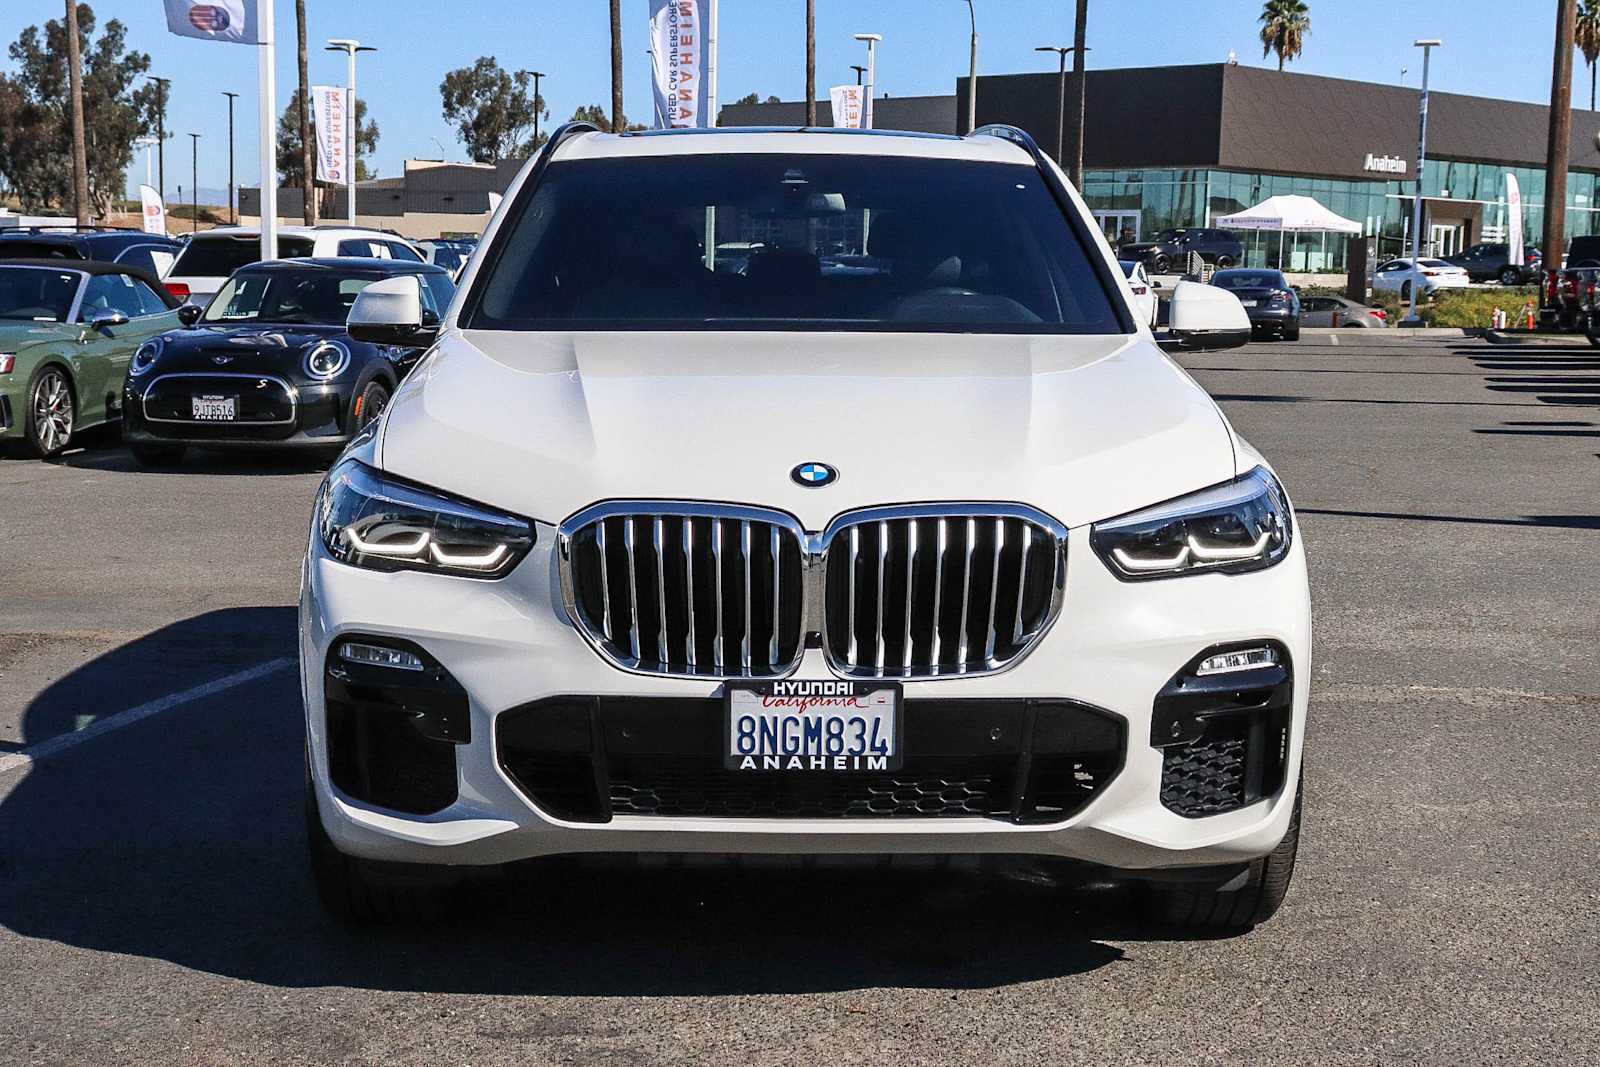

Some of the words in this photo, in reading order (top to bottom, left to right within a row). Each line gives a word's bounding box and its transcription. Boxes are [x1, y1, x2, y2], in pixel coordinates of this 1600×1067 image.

[1363, 153, 1407, 174] Anaheim
[773, 681, 854, 696] HYUNDAI
[762, 695, 870, 714] California
[737, 715, 889, 756] 8NGM834
[739, 755, 887, 770] ANAHEIM
